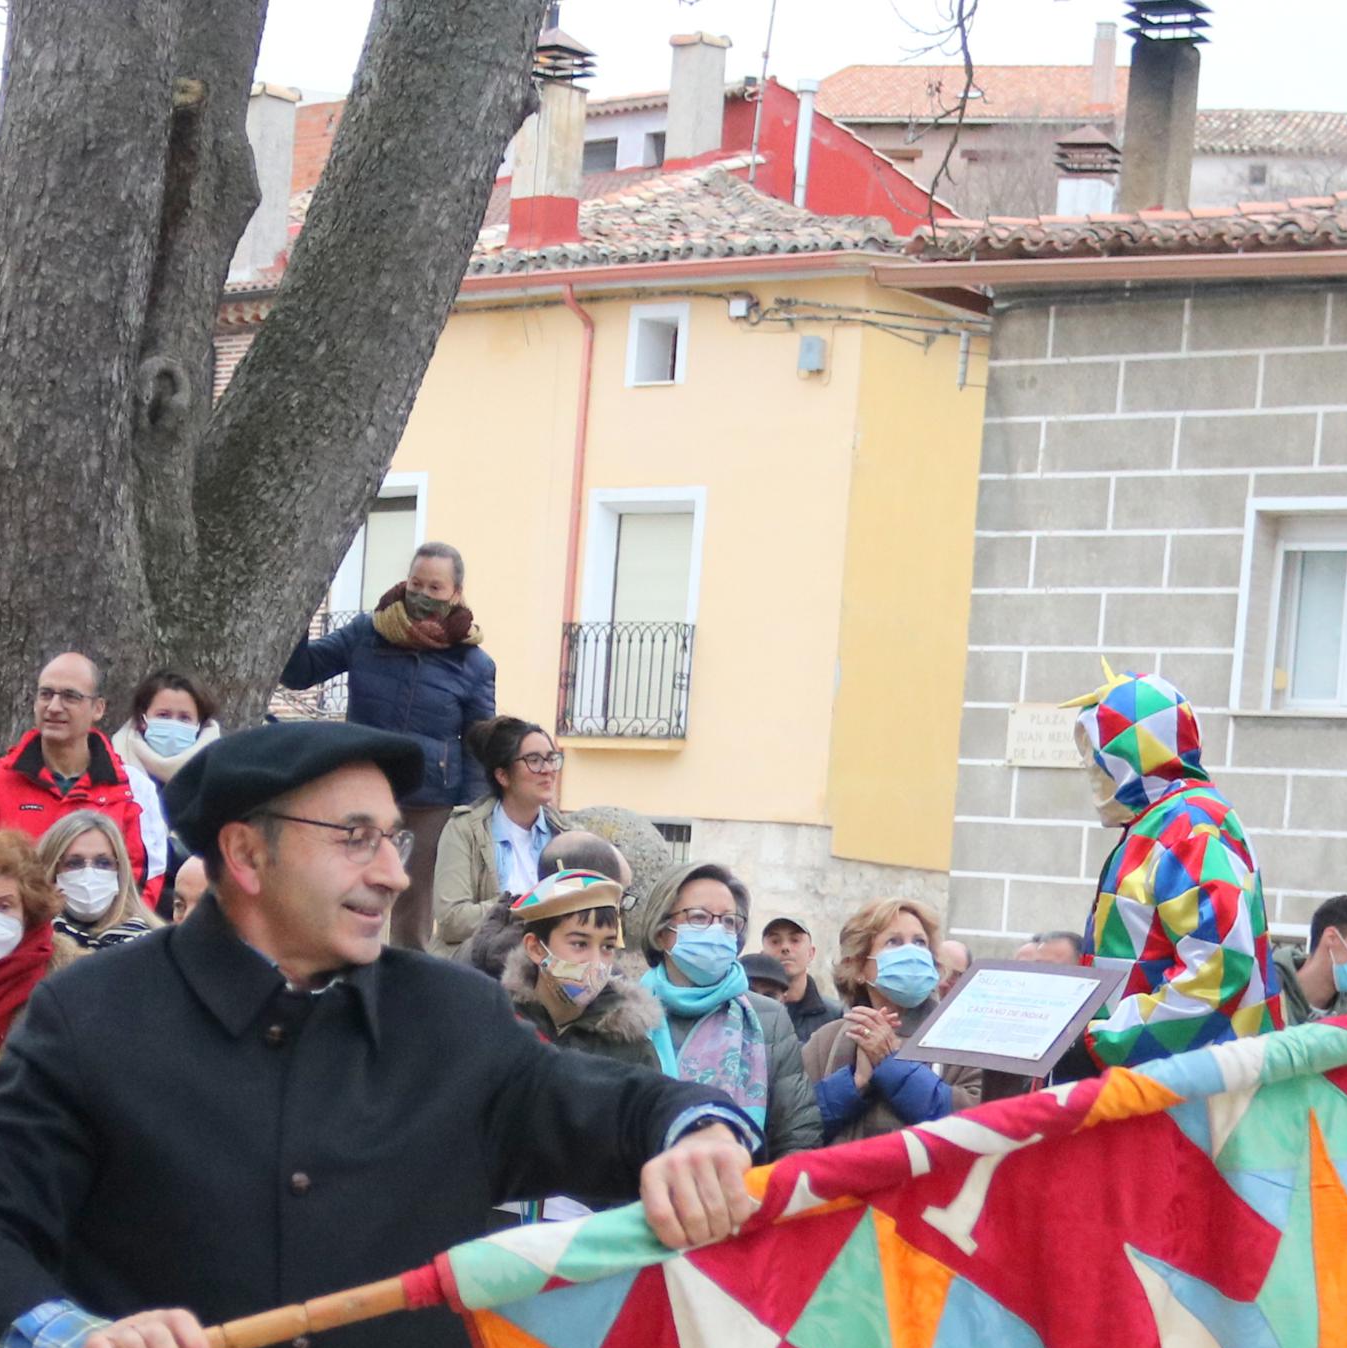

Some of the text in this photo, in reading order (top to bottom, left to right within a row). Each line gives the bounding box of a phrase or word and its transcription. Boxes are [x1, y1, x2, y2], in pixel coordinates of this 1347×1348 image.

[1030, 713, 1067, 725] PLAZA
[1013, 748, 1027, 760] DE
[1032, 748, 1047, 760] LA
